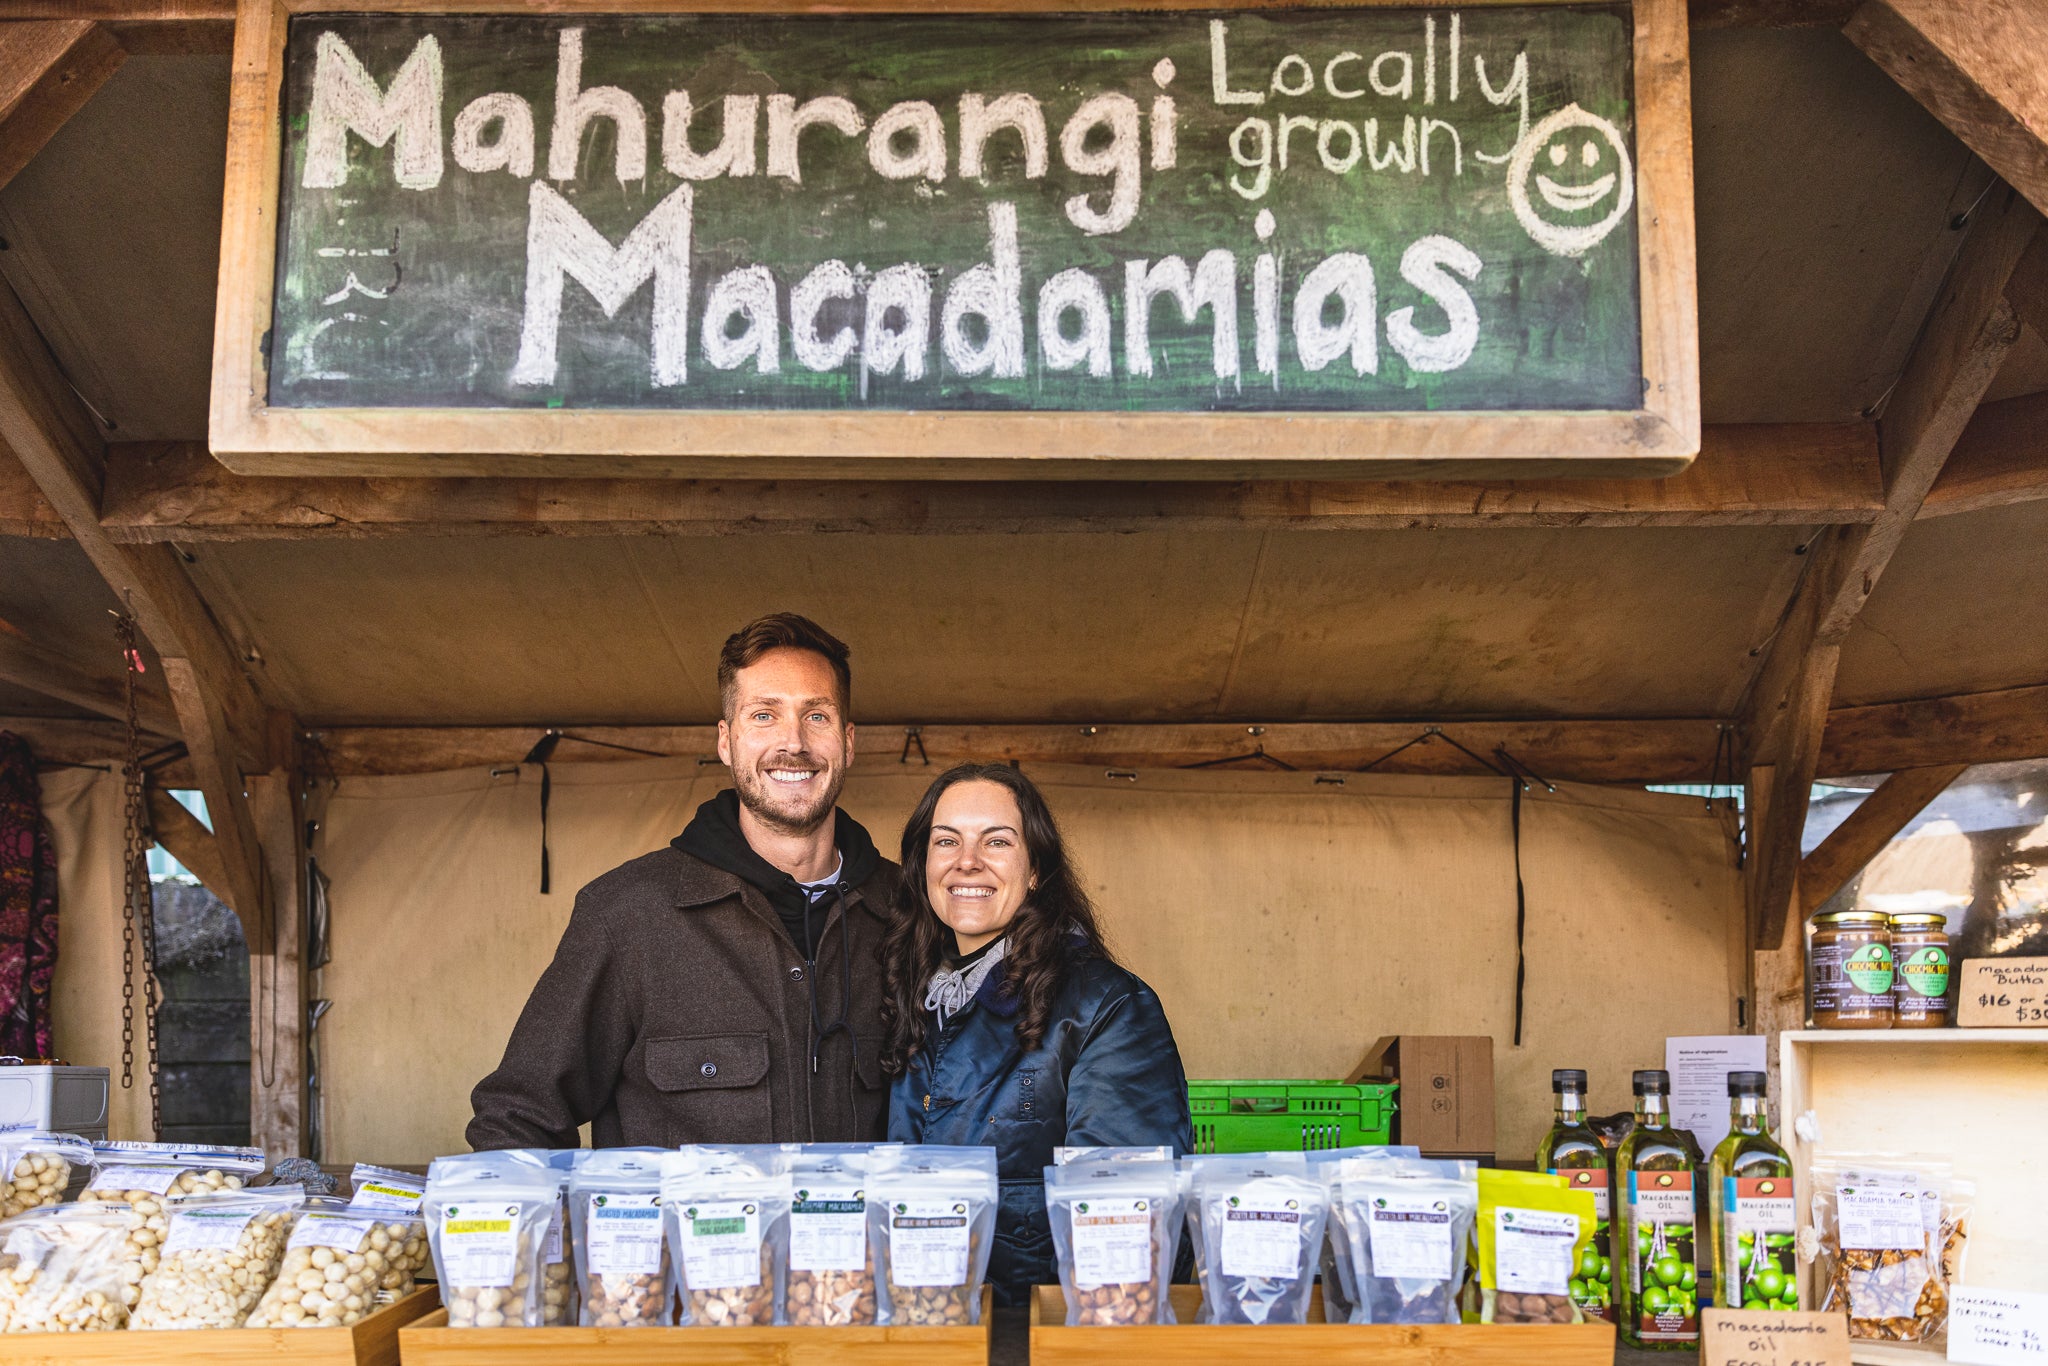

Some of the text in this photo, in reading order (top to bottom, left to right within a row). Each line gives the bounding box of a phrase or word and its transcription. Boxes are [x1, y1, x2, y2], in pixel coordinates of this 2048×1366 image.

[1209, 13, 1529, 164] Locally
[303, 28, 1176, 236] Mahurangi
[1229, 114, 1462, 200] grown
[511, 180, 1484, 388] Macadamias
[1978, 993, 2011, 1008] $16
[1993, 974, 2044, 985] Butta
[1748, 1335, 1776, 1351] oil
